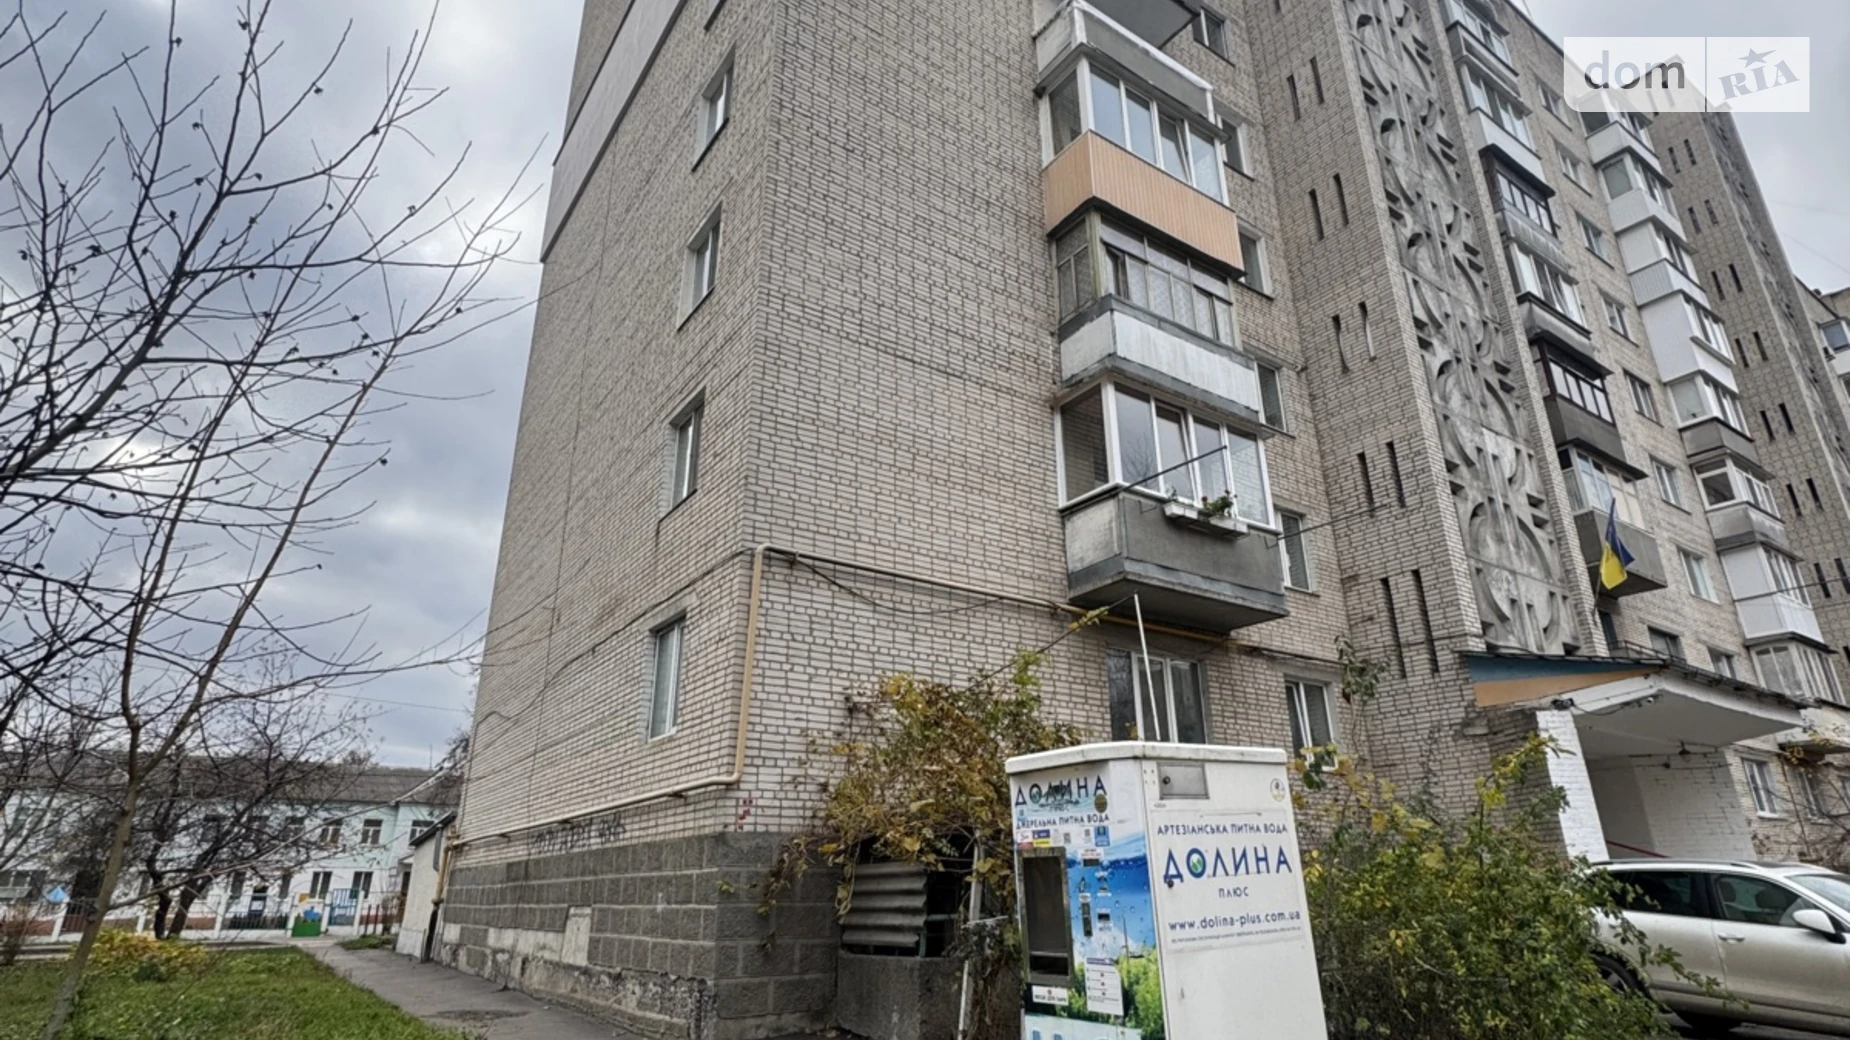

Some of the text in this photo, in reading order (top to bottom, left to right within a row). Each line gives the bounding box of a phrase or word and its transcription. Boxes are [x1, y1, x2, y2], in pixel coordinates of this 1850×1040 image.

[1015, 774, 1107, 807] ДОЛИНА
[1059, 815, 1085, 826] ПИТНА
[1087, 813, 1110, 824] ВОДА
[1157, 823, 1288, 835] АРТЕЗІАНСЬКА ПИТНА ВОДА
[1163, 844, 1293, 883] ДОЛИНА
[1218, 887, 1249, 898] ПЛЮС
[1168, 910, 1301, 931] www.dolina-plus.com.ua
